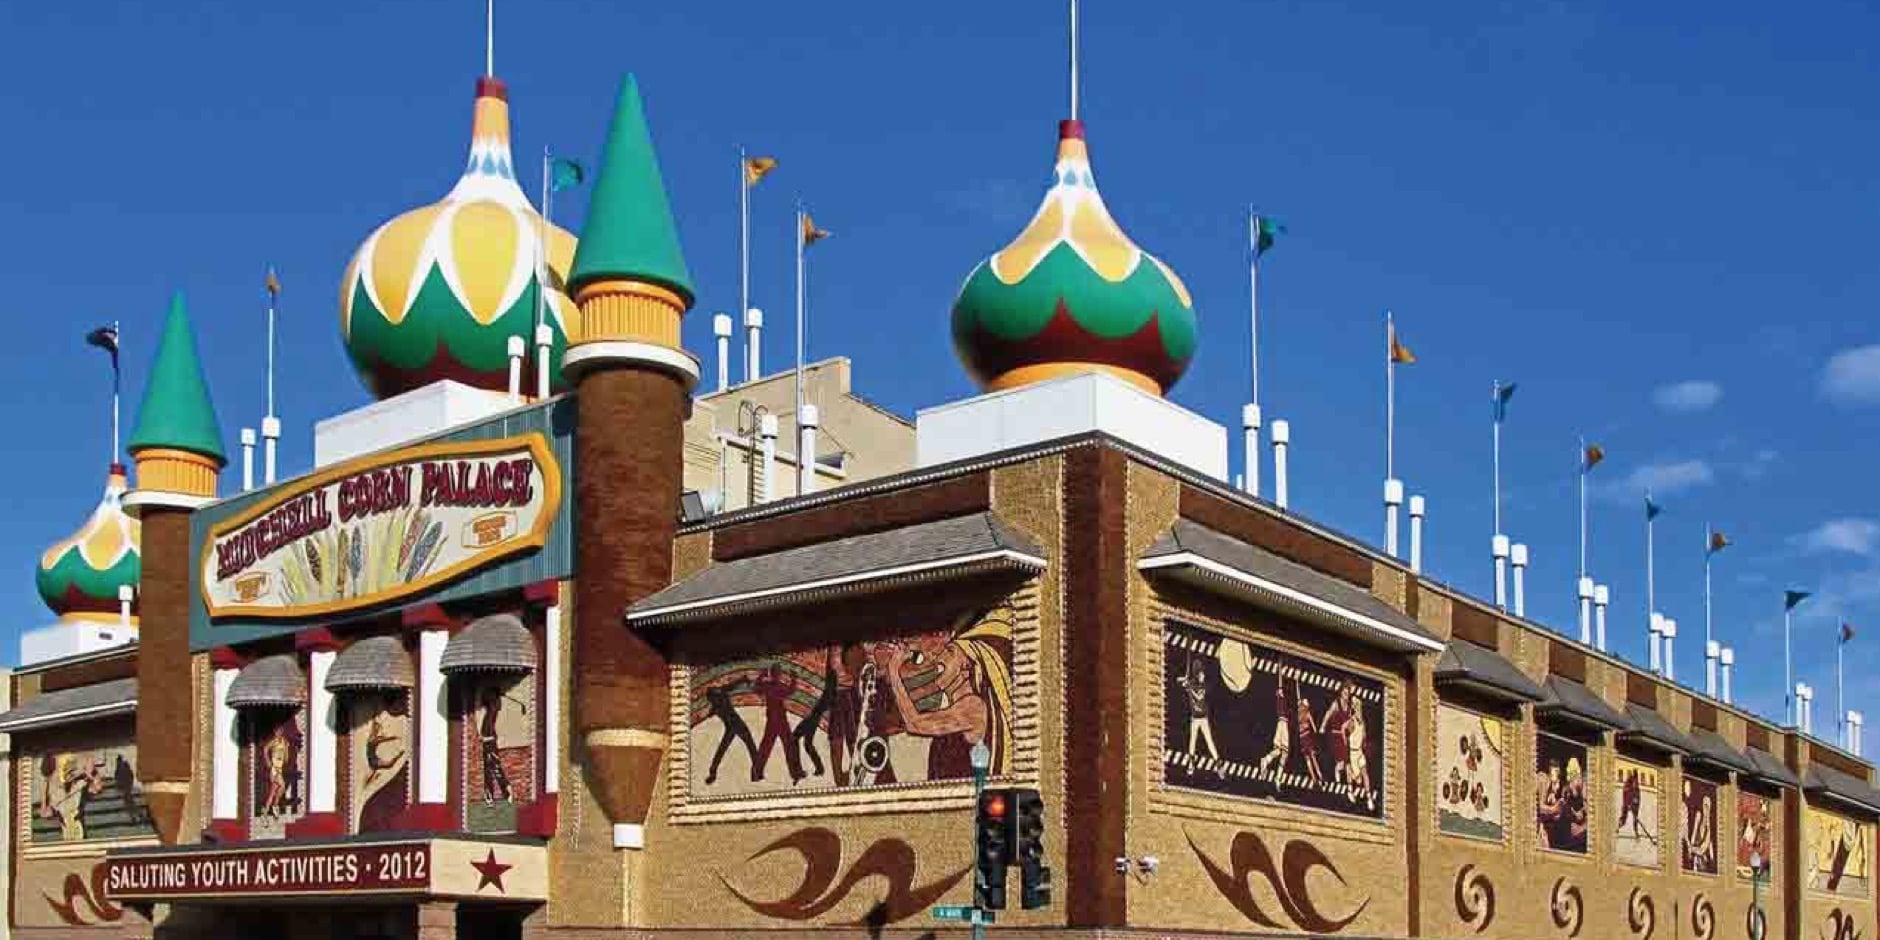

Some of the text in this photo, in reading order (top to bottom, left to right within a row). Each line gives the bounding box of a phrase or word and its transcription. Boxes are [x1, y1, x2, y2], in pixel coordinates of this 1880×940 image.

[216, 458, 533, 581] MITCHELL CORN PALACE
[110, 851, 426, 889] SALUTING YOUTH ACTIVITIES 2012
